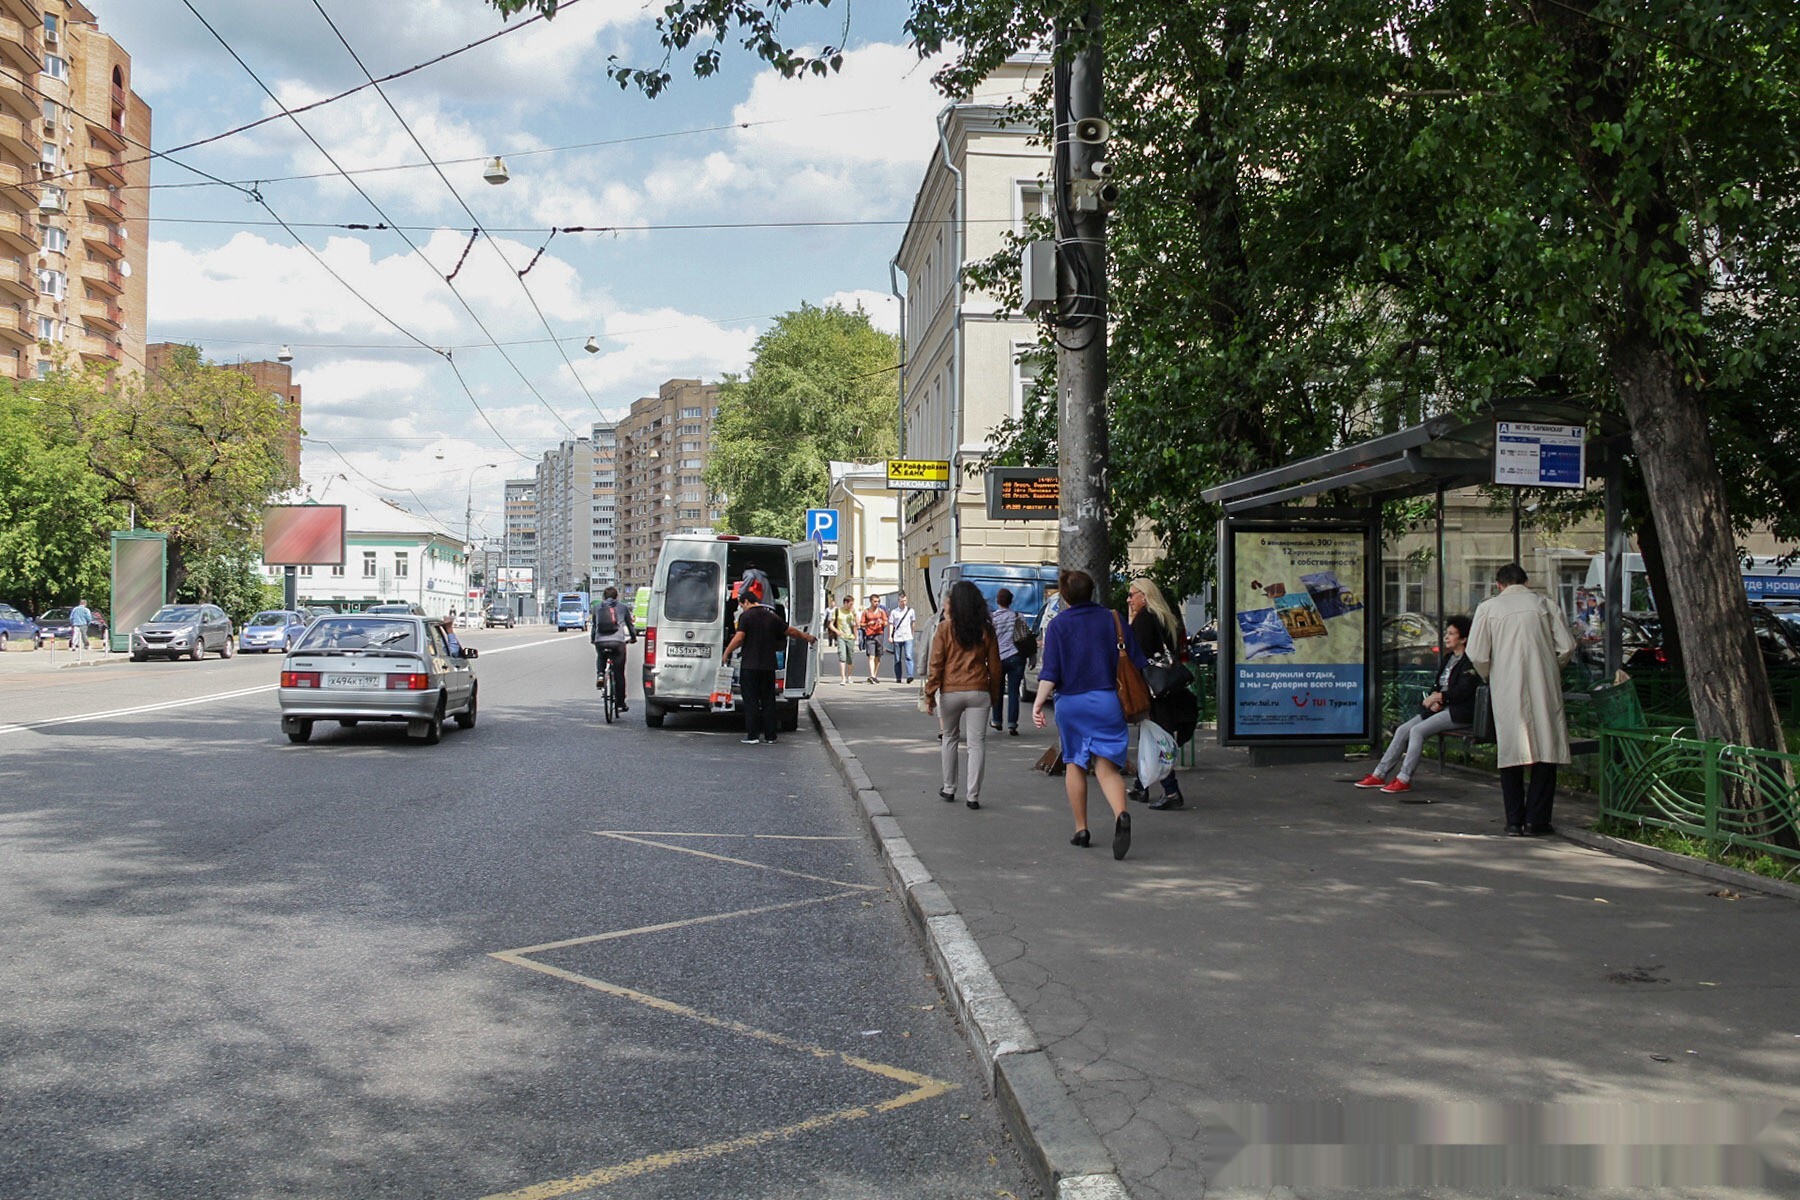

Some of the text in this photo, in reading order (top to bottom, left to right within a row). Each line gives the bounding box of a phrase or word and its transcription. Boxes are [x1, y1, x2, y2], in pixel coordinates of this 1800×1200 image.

[903, 463, 947, 471] Райффайзен
[815, 512, 833, 531] P
[1260, 538, 1265, 546] 6
[1317, 538, 1332, 546] 300
[825, 564, 835, 572] 20
[1239, 669, 1336, 680] Вы заслужили отдых,
[1271, 681, 1308, 690] доверие
[1335, 681, 1358, 689] мира
[1239, 698, 1280, 707] www.tui.ru
[1312, 698, 1358, 708] TUI Туризм
